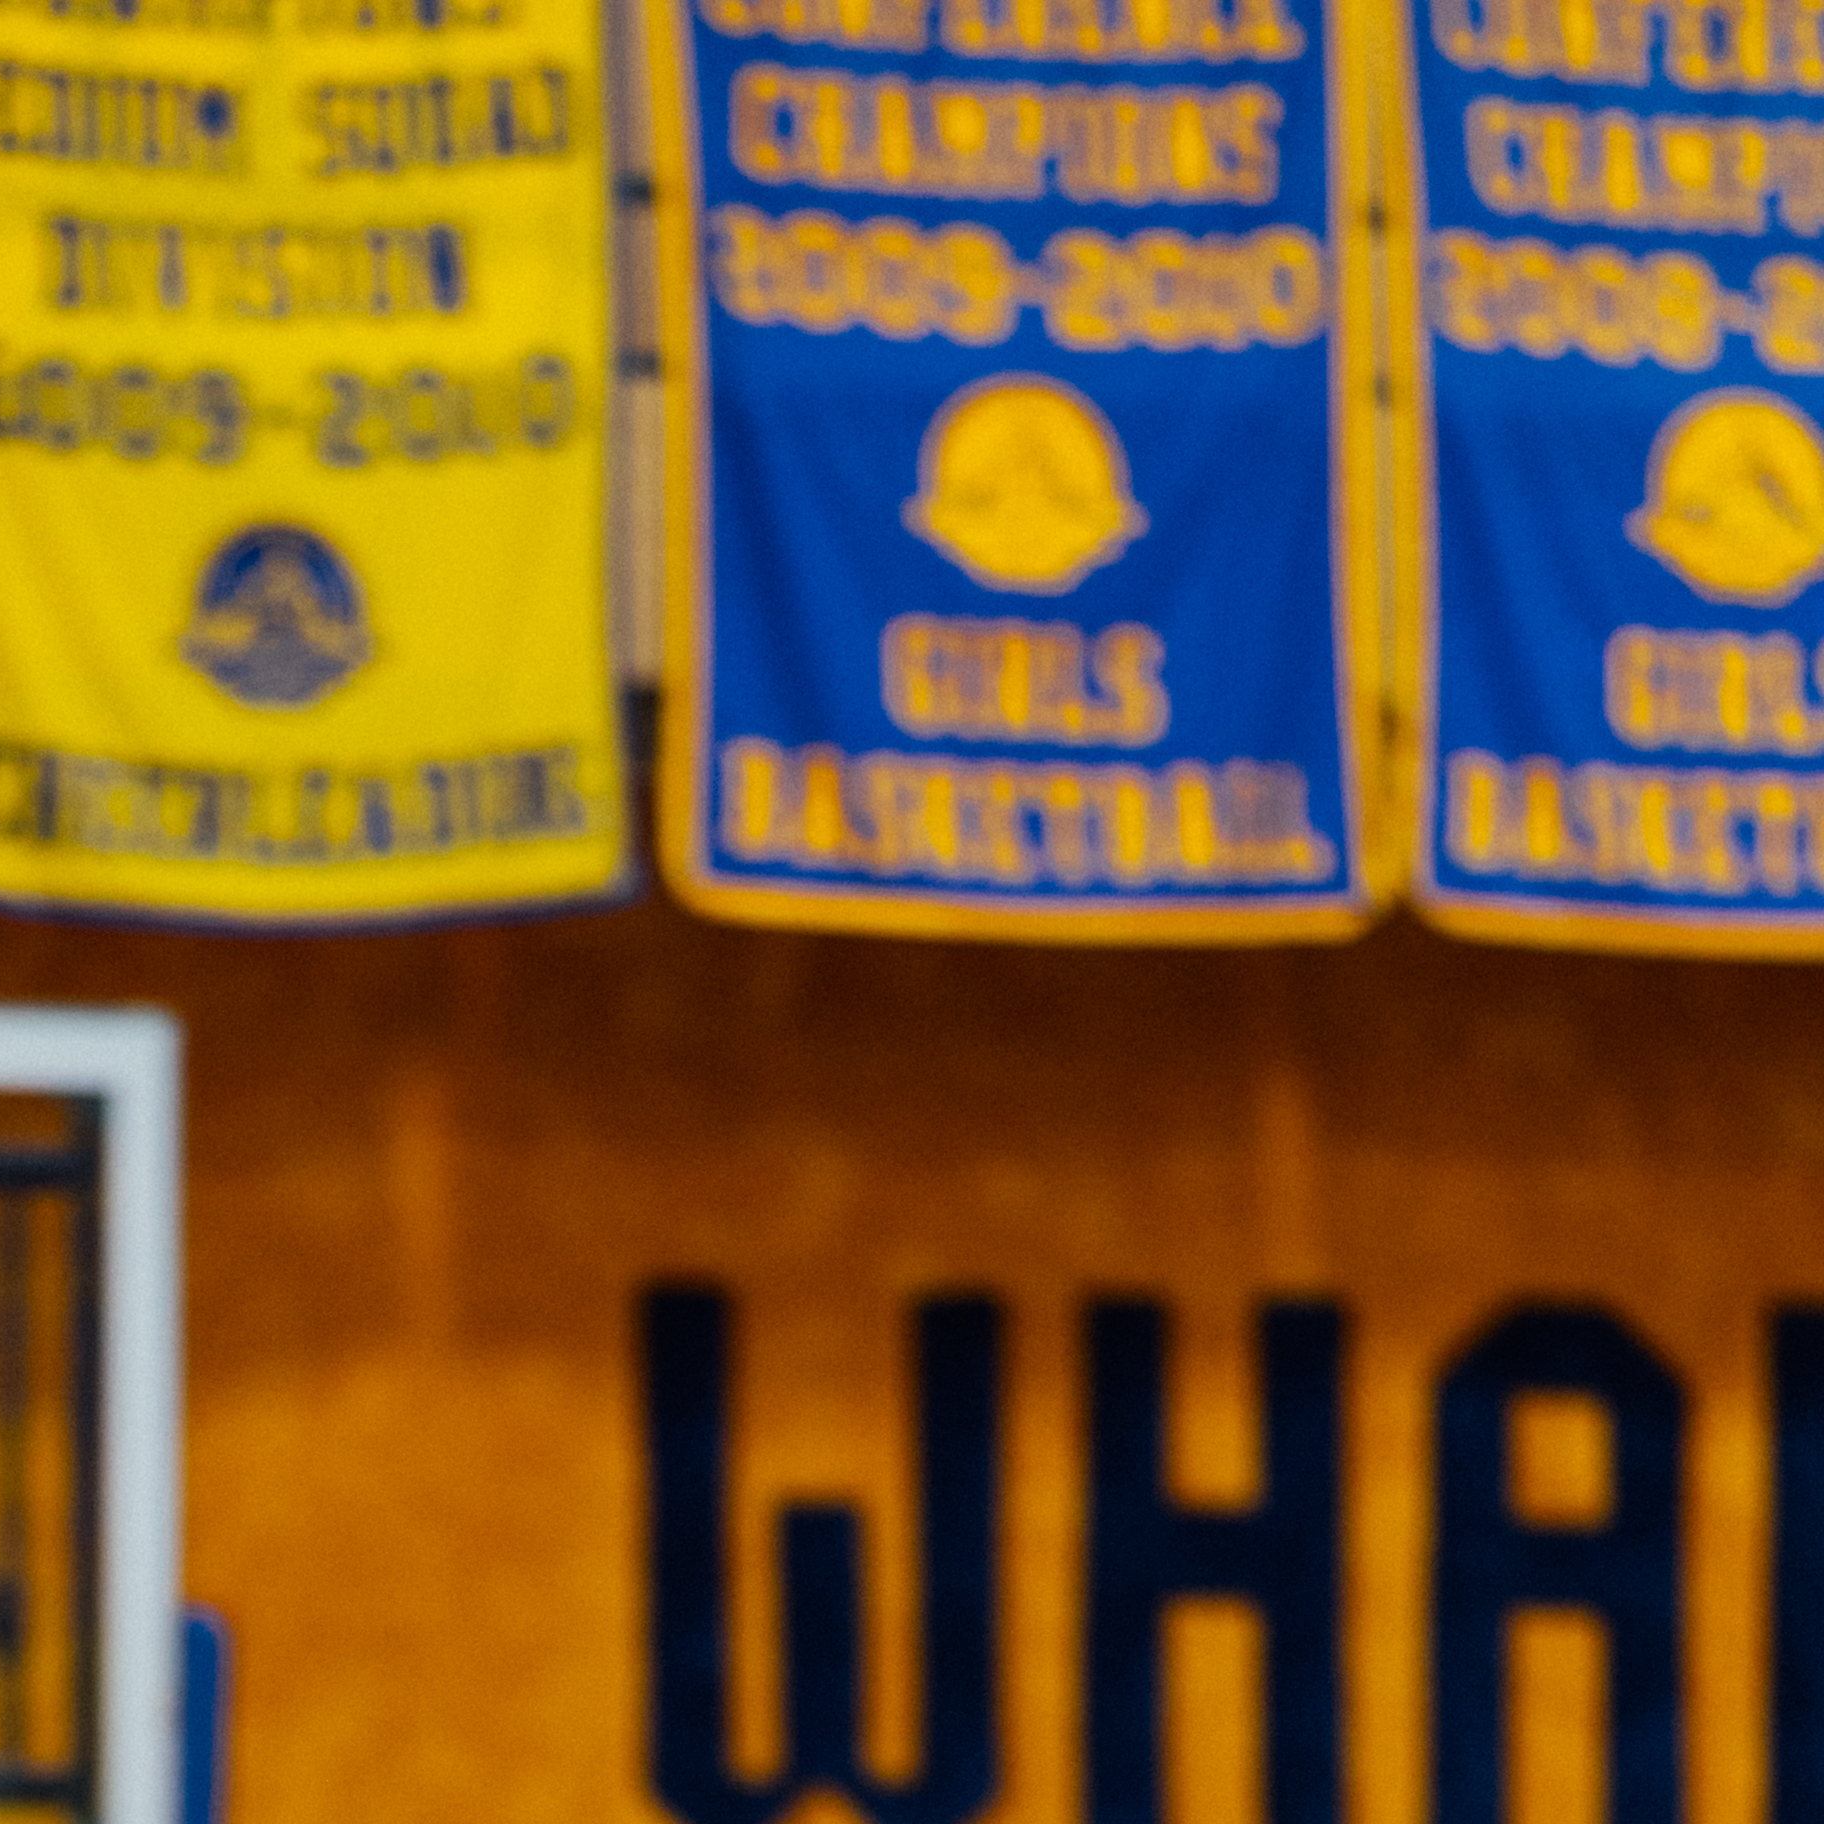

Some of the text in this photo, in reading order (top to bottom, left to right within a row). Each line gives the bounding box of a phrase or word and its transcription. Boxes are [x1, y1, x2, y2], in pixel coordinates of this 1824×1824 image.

[730, 62, 1284, 206] CHAMPIONS
[44, 215, 473, 320] DIVISION
[880, 612, 1169, 748] GIRLS
[1603, 622, 1824, 757] GIRL
[719, 738, 1336, 887] BASKETBALL
